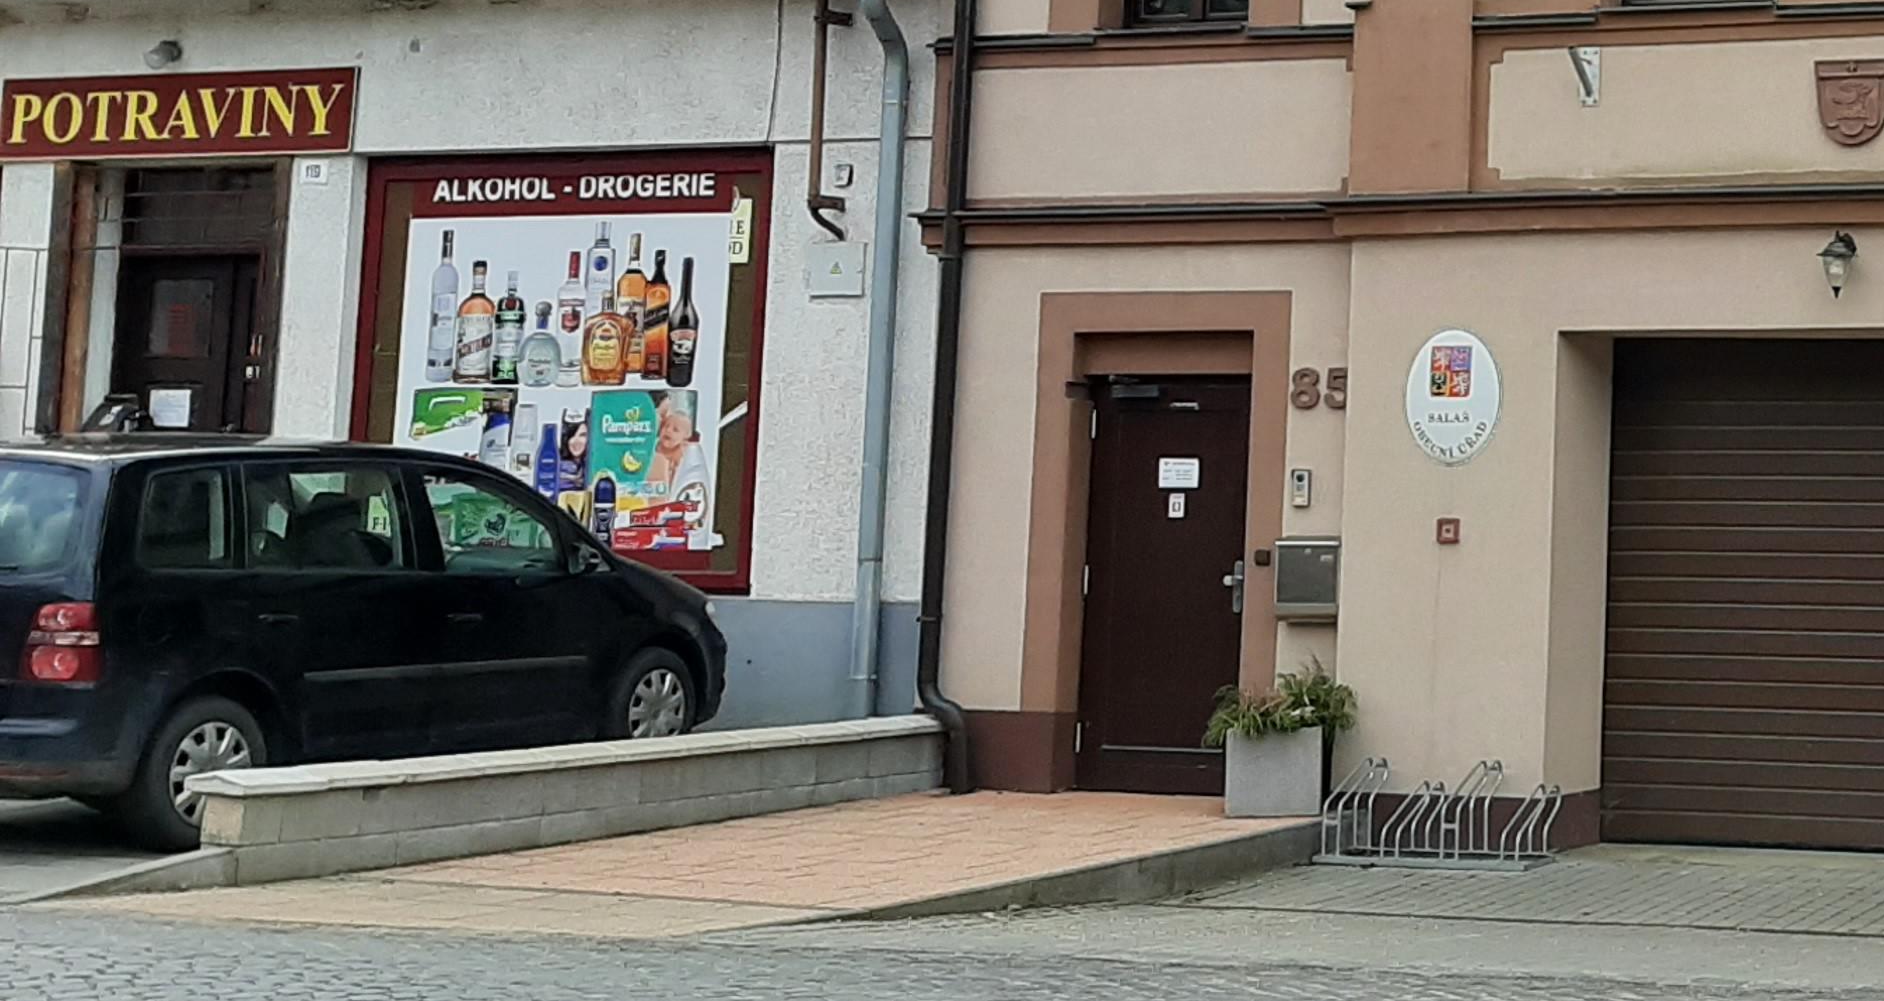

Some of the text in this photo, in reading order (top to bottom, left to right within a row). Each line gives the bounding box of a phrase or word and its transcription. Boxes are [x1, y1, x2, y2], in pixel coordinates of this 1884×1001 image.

[7, 83, 345, 144] POTRAVINY
[433, 177, 556, 202] ALKOHOL
[579, 173, 716, 198] DROGERIE
[1291, 367, 1348, 410] 85
[1428, 410, 1470, 423] SALAŠ
